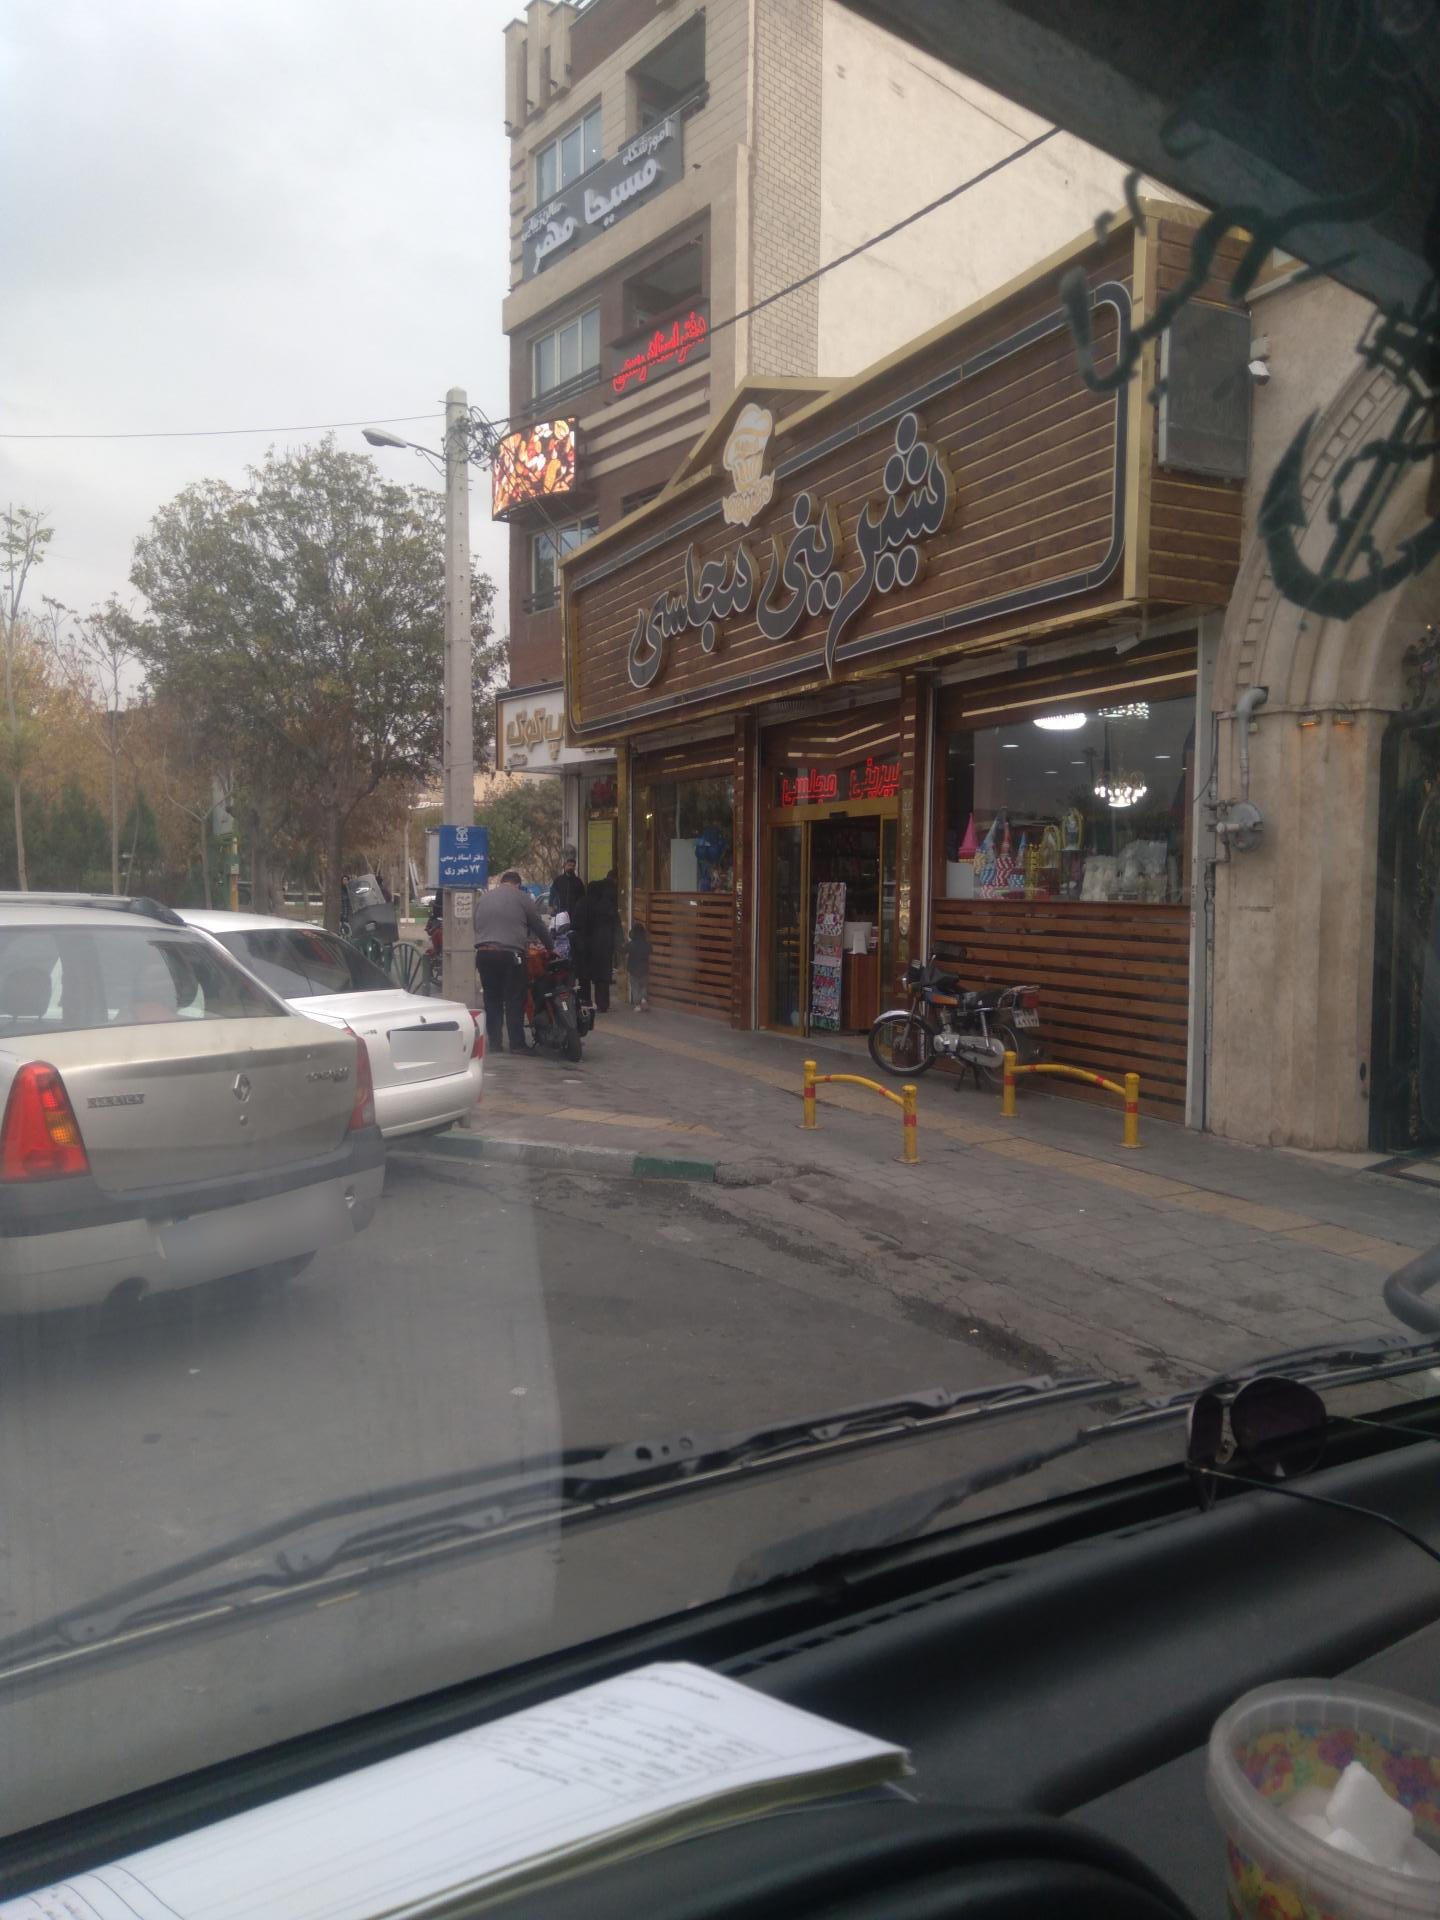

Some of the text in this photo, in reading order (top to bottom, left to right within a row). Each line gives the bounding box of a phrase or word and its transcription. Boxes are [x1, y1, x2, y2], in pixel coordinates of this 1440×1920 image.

[533, 158, 658, 274] مسیحا مهر
[628, 411, 951, 689] شیرینی مجلسی
